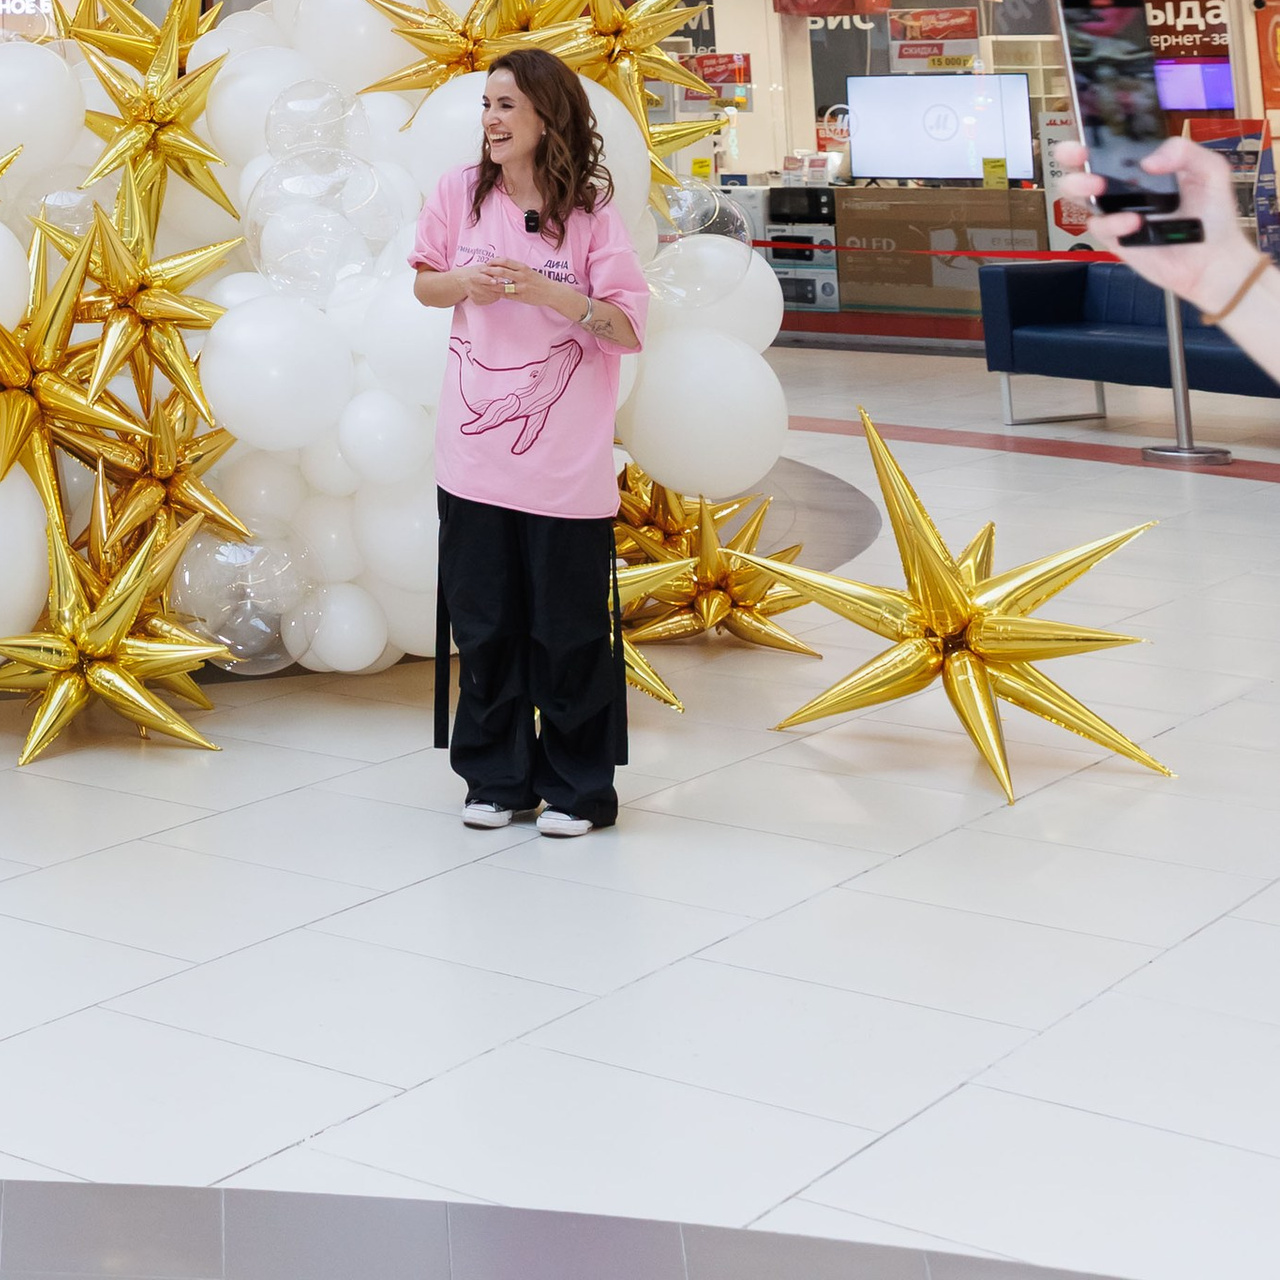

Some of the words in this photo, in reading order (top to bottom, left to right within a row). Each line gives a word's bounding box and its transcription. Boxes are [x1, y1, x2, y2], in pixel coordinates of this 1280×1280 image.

[932, 57, 943, 66] 15
[945, 57, 961, 66] 000
[544, 260, 569, 270] ДИНА
